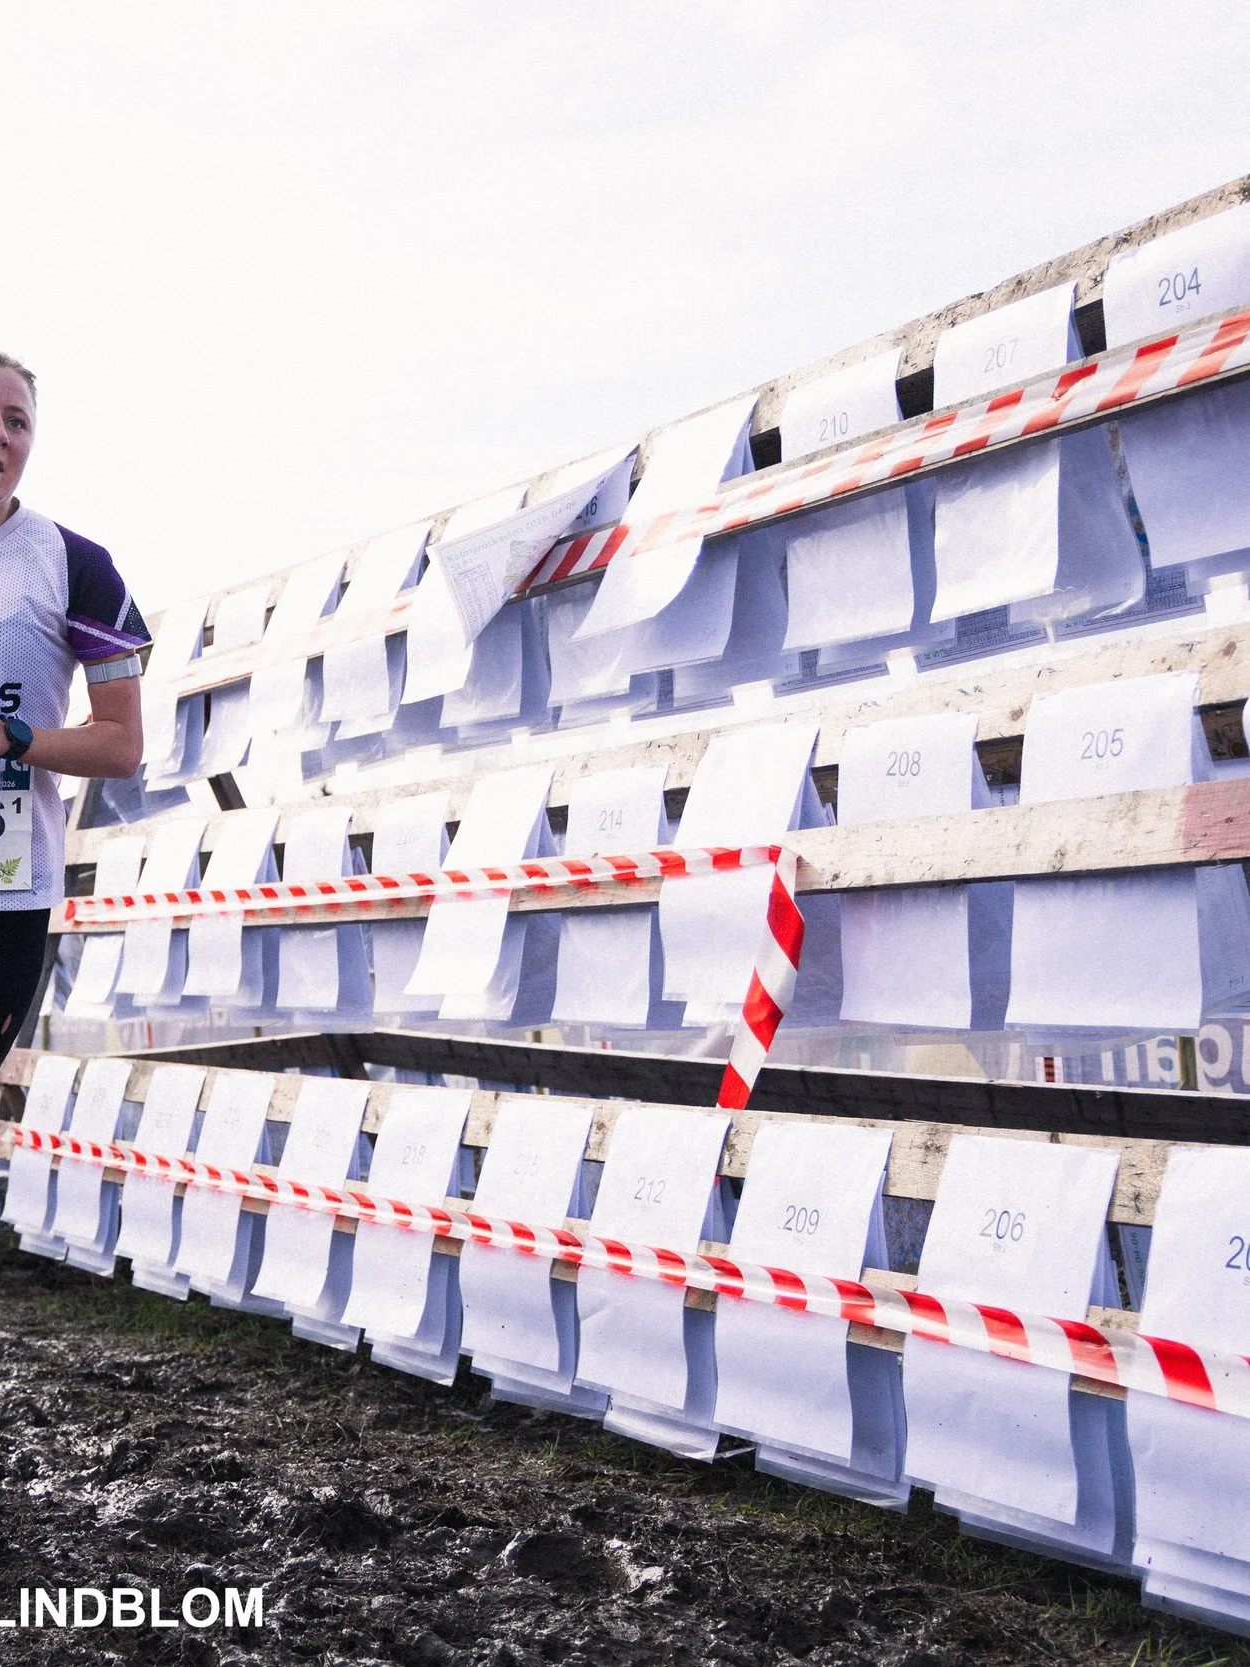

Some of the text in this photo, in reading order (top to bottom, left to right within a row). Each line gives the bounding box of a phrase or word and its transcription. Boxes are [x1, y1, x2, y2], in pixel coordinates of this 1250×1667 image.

[1158, 267, 1201, 307] 204
[983, 338, 1018, 374] 207
[819, 411, 849, 441] 210
[576, 496, 598, 520] 16
[1081, 728, 1124, 760] 205
[885, 751, 921, 776] 208
[1, 780, 16, 788] 026
[11, 798, 22, 814] 1
[598, 809, 623, 831] 214
[633, 1176, 666, 1204] 212
[782, 1205, 820, 1235] 209
[979, 1208, 1026, 1242] 206
[1225, 1235, 1250, 1271] 2
